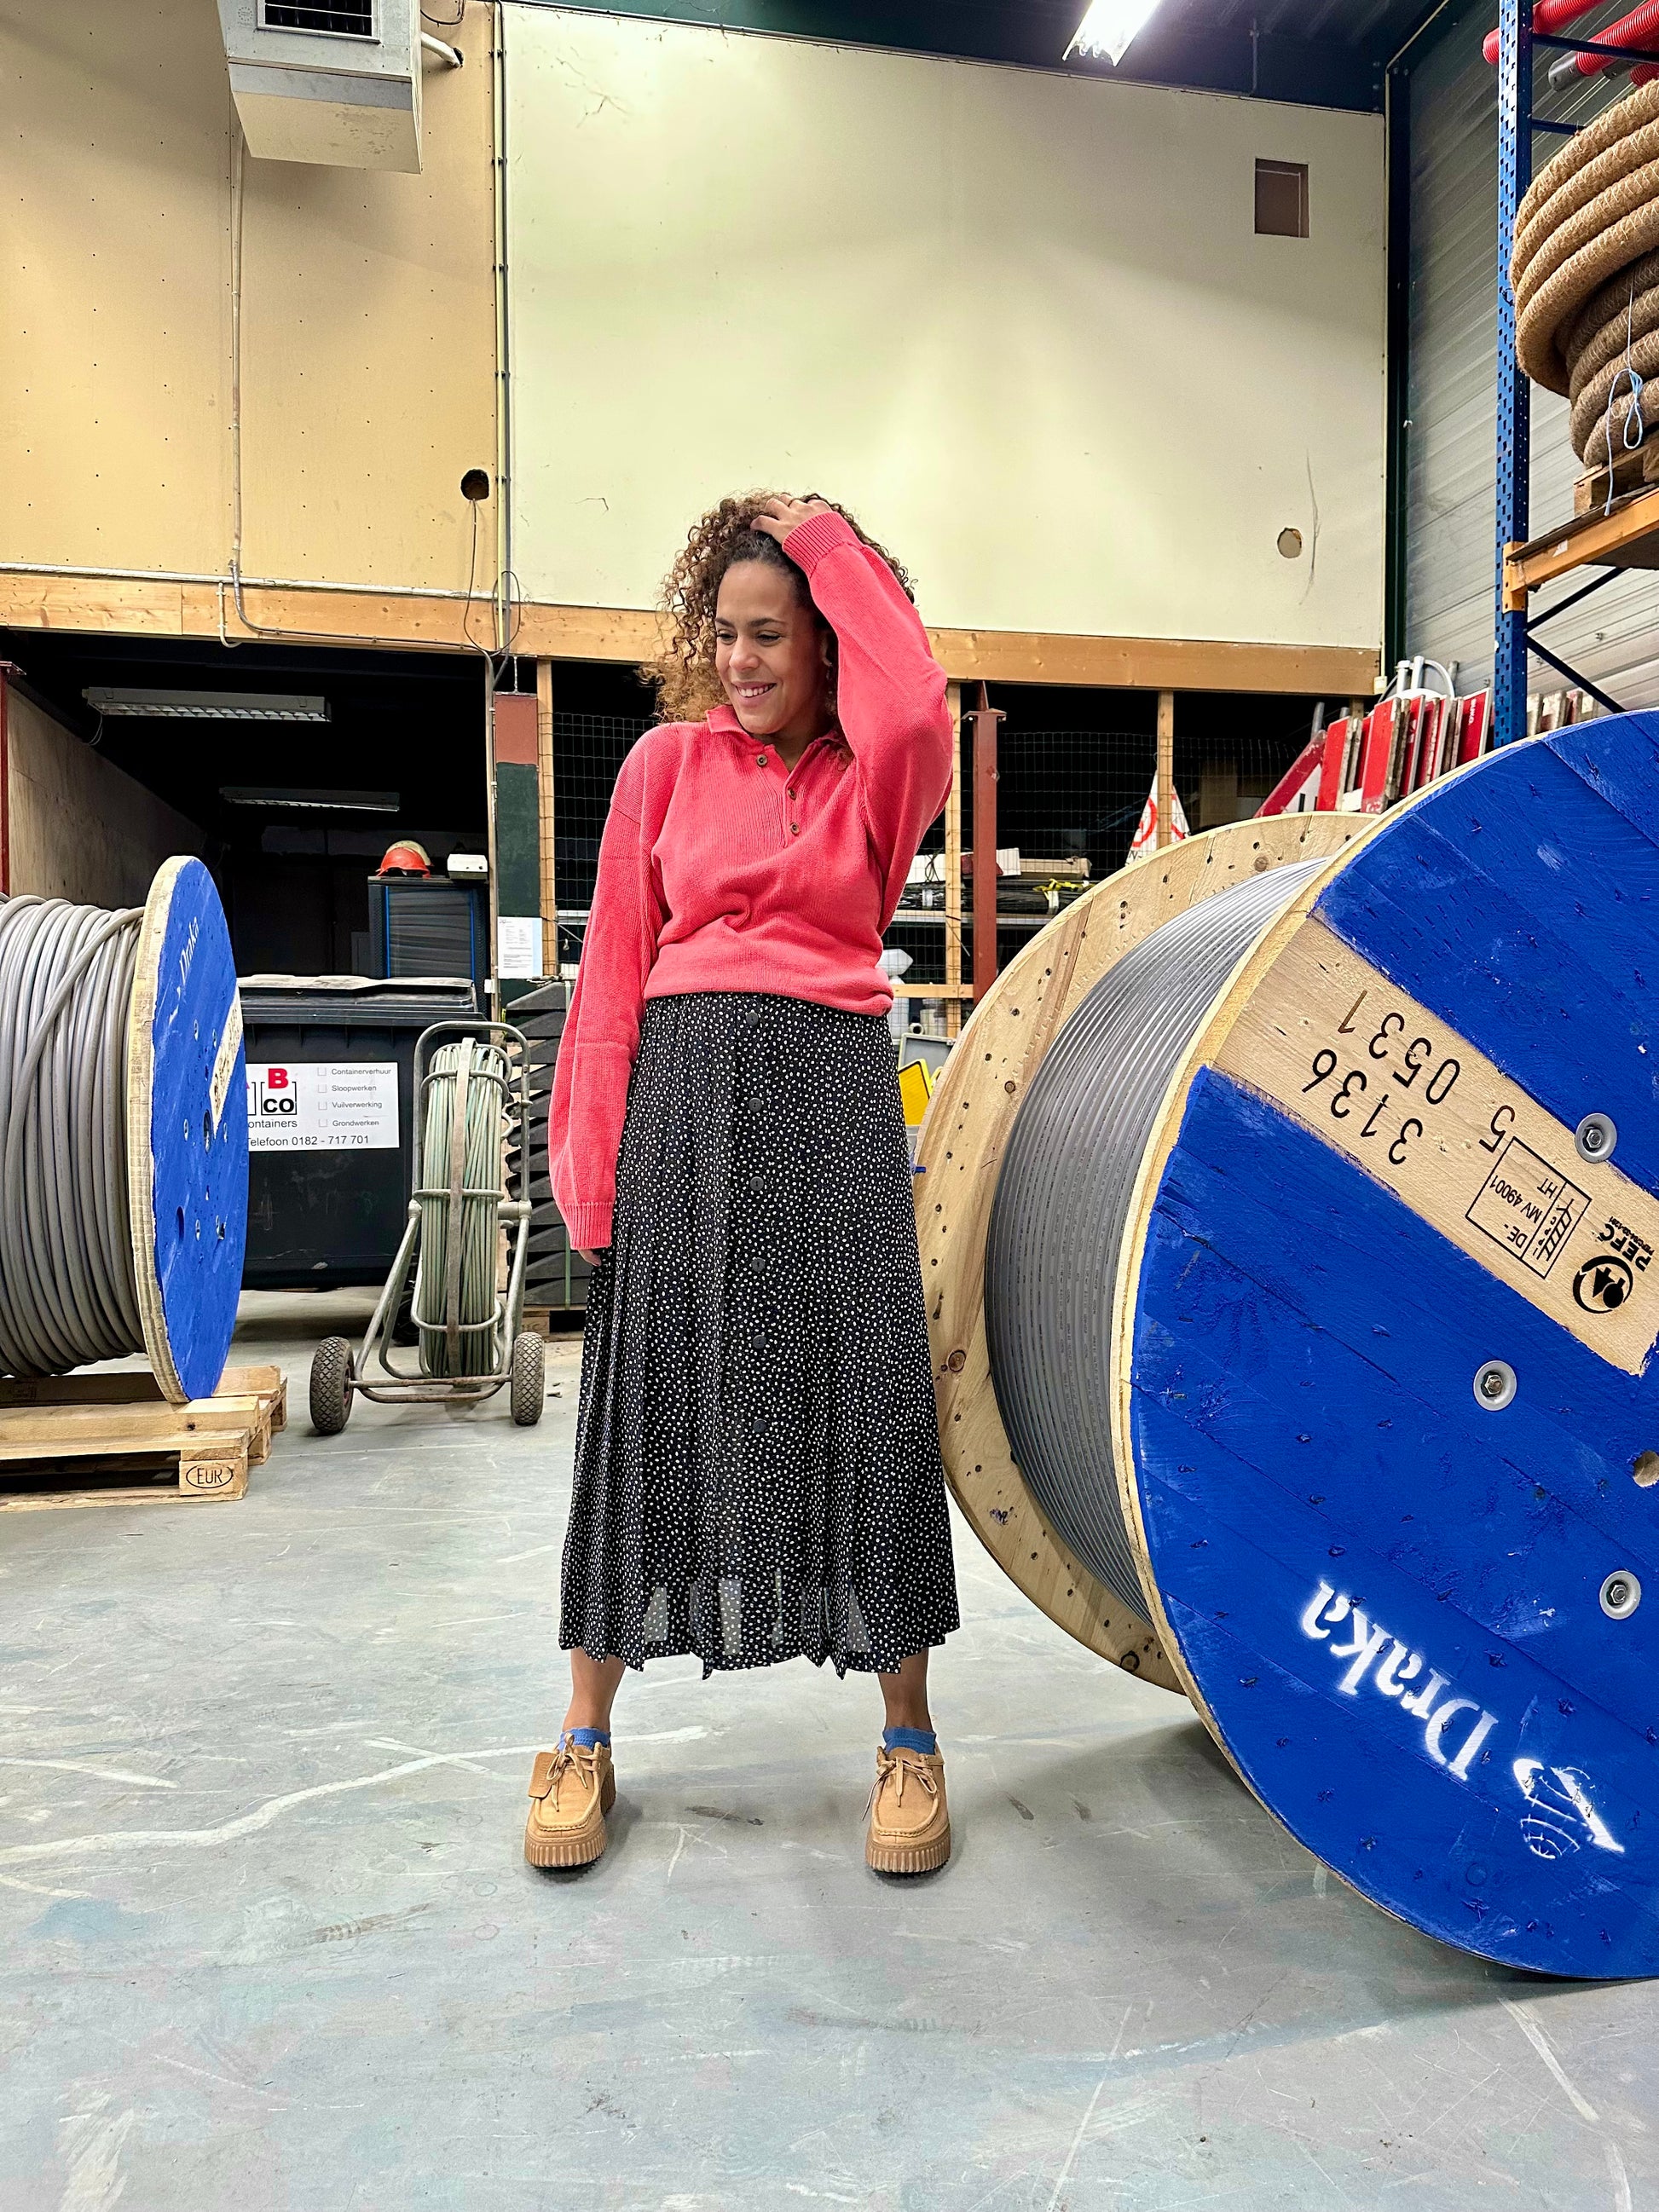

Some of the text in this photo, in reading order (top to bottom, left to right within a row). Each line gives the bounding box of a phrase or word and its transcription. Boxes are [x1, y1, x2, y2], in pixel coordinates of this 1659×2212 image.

[268, 1068, 289, 1089] B
[1338, 990, 1515, 1152] 5 0531
[247, 1118, 298, 1129] ontainers
[1302, 1048, 1423, 1164] 3136
[247, 1136, 289, 1146] elefoon
[292, 1135, 318, 1146] 0182
[328, 1135, 347, 1145] 717
[350, 1135, 368, 1145] 701
[1489, 1175, 1543, 1224] MV 49001
[1536, 1178, 1558, 1199] HT
[1598, 1223, 1652, 1273] PEFC
[197, 1467, 223, 1485] EUR
[1301, 1580, 1500, 1782] Draka
